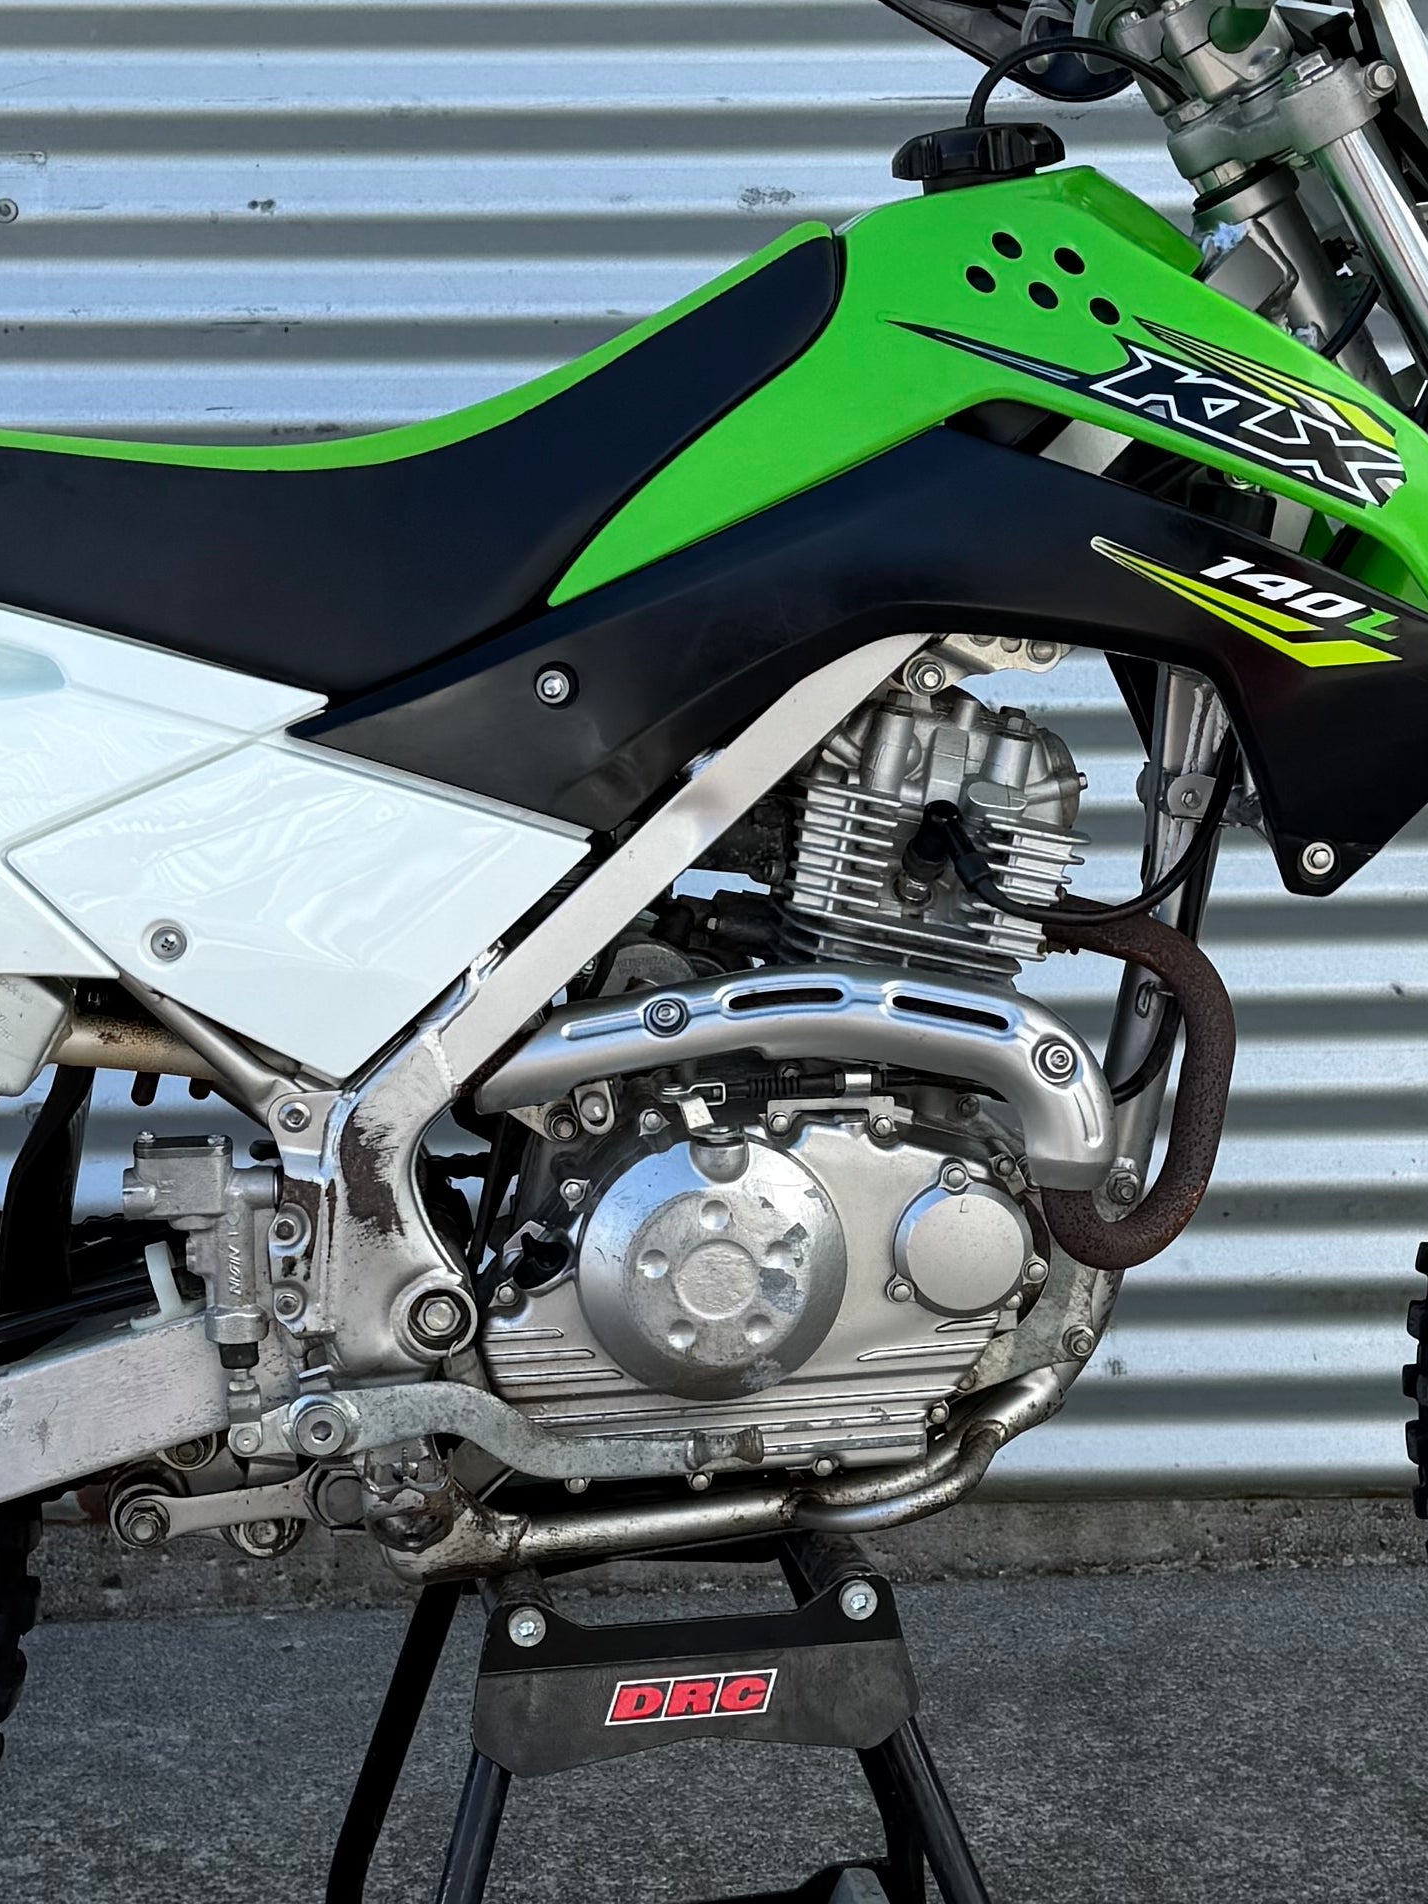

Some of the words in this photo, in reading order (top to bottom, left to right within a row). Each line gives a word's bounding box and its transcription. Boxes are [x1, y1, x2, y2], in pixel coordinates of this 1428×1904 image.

[1089, 339, 1406, 507] KLX
[1199, 555, 1400, 642] 140L
[610, 1675, 768, 1721] DRC
